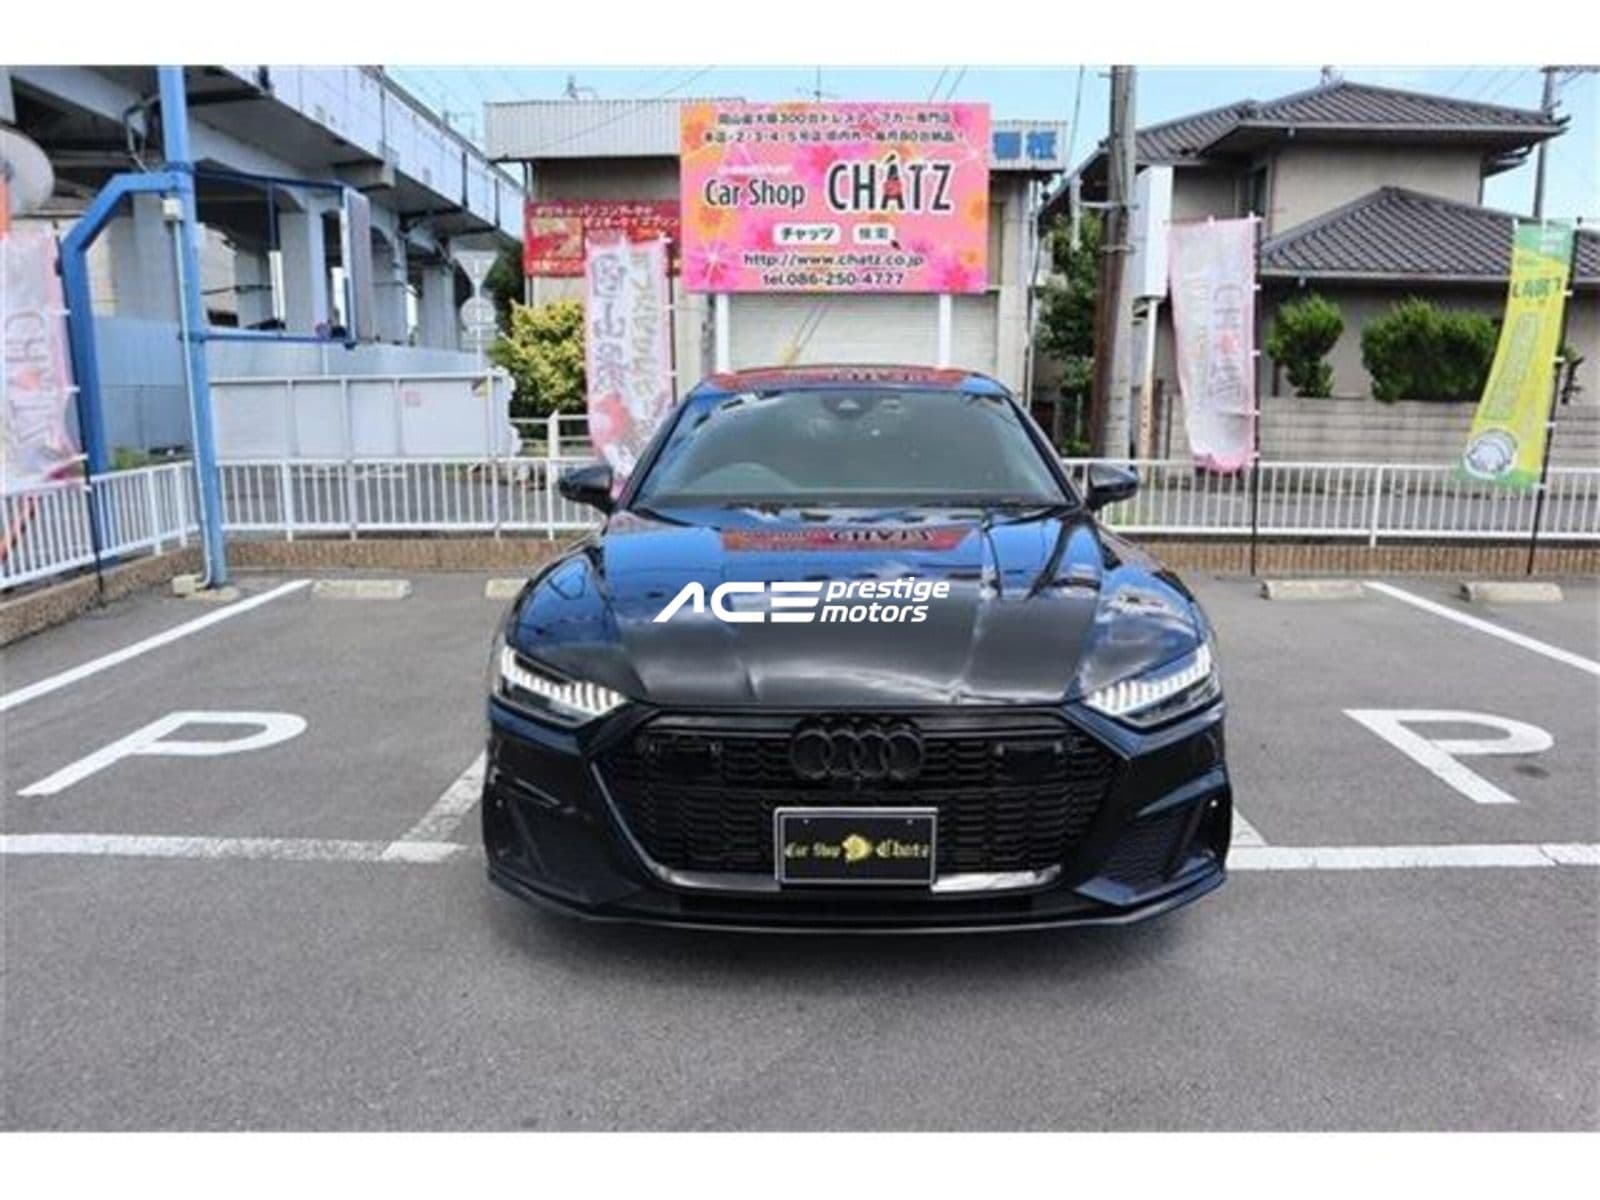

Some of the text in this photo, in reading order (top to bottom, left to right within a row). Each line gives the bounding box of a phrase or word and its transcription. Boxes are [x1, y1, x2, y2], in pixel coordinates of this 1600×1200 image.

[705, 180, 742, 205] Car
[750, 179, 806, 208] Shop
[780, 227, 834, 241] チャッツ
[744, 253, 924, 267] http://www.chatz.co.jp
[763, 272, 904, 286] tel.086-250-4777
[16, 711, 307, 796] P
[1341, 709, 1554, 804] P
